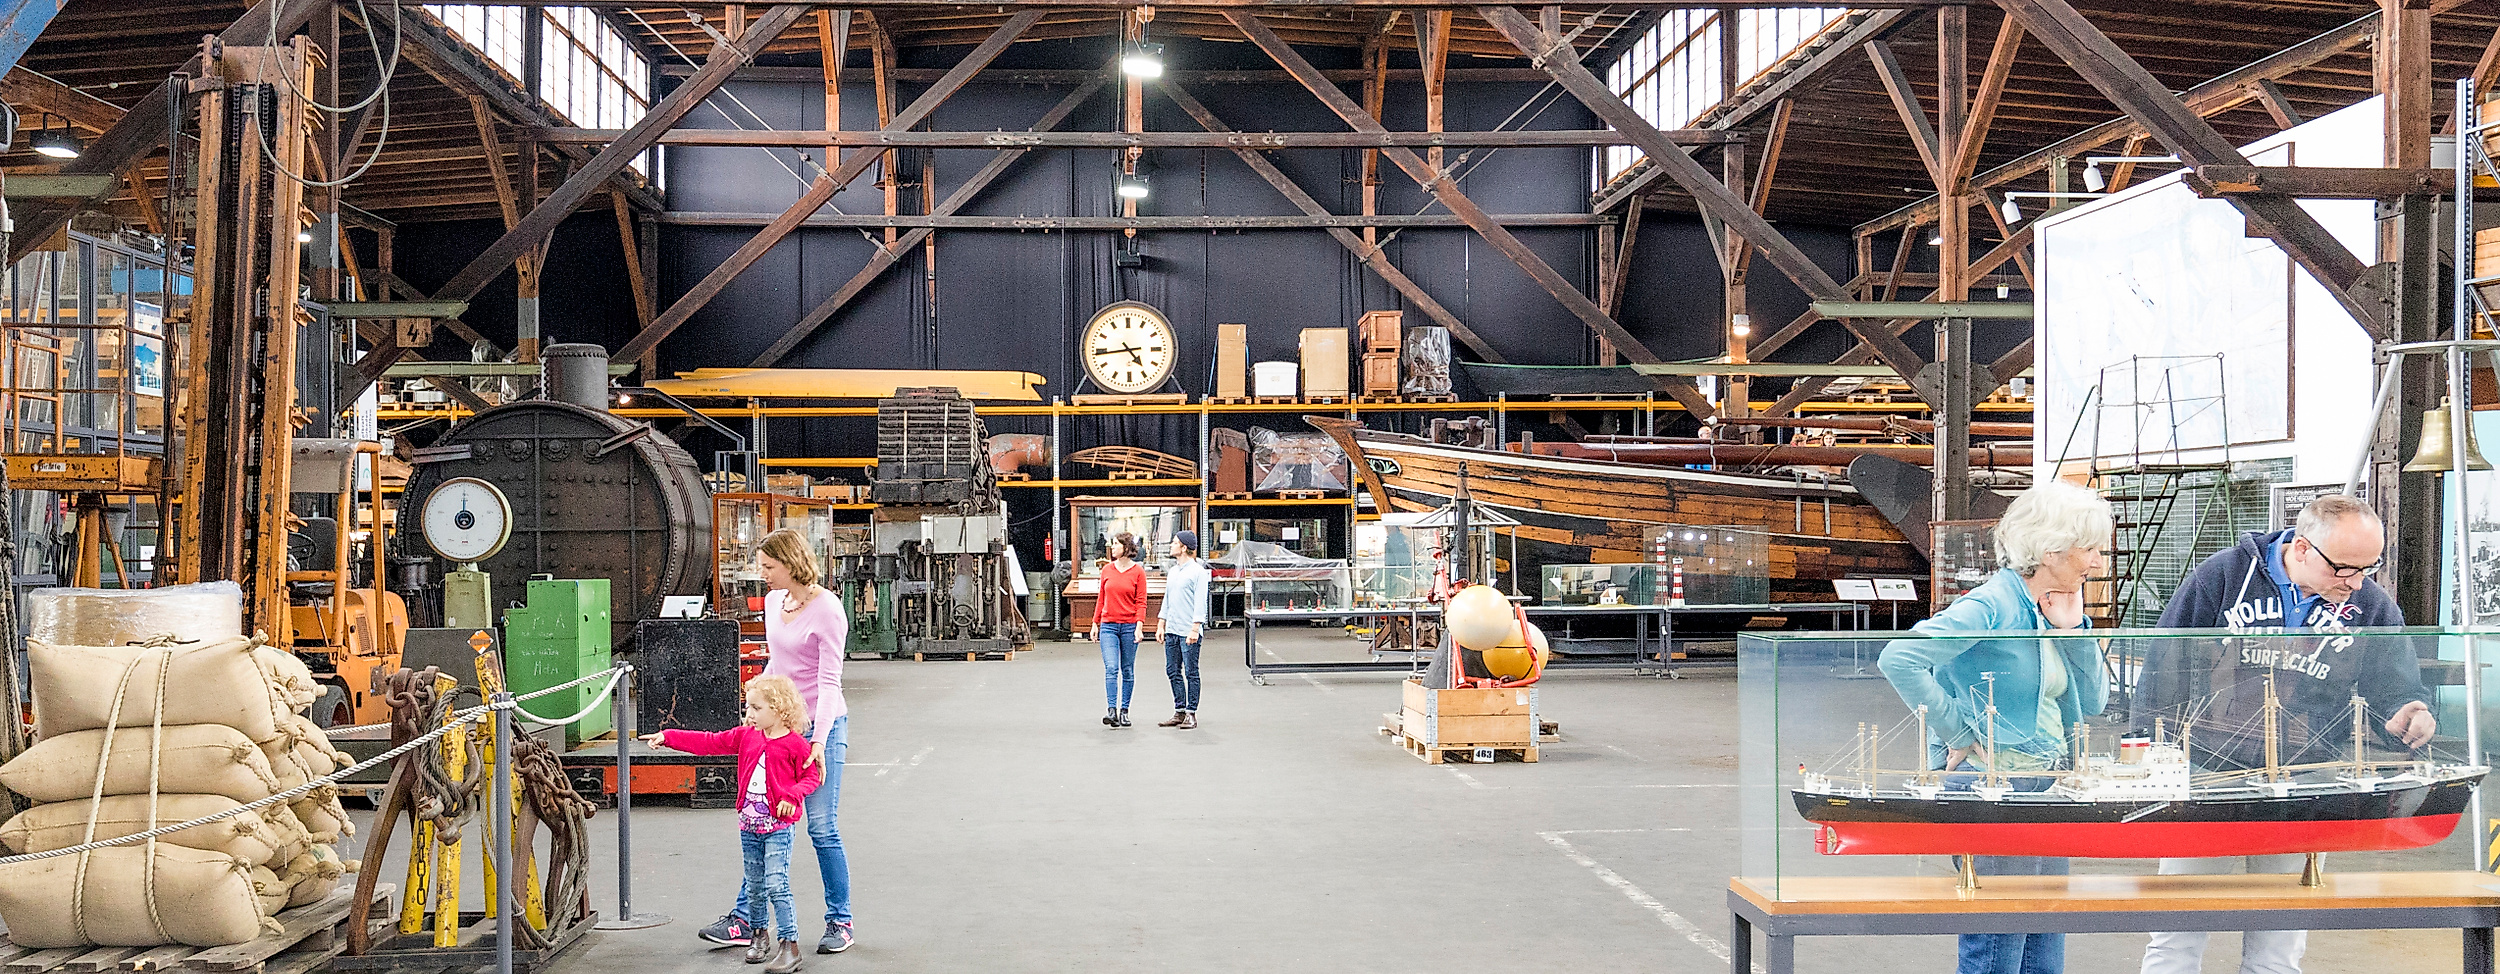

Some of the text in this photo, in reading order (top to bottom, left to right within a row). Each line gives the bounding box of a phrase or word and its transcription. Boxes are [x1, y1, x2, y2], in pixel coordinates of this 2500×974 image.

[2241, 649, 2331, 680] SURF CLUB
[1475, 750, 1492, 758] 463
[728, 925, 741, 938] N
